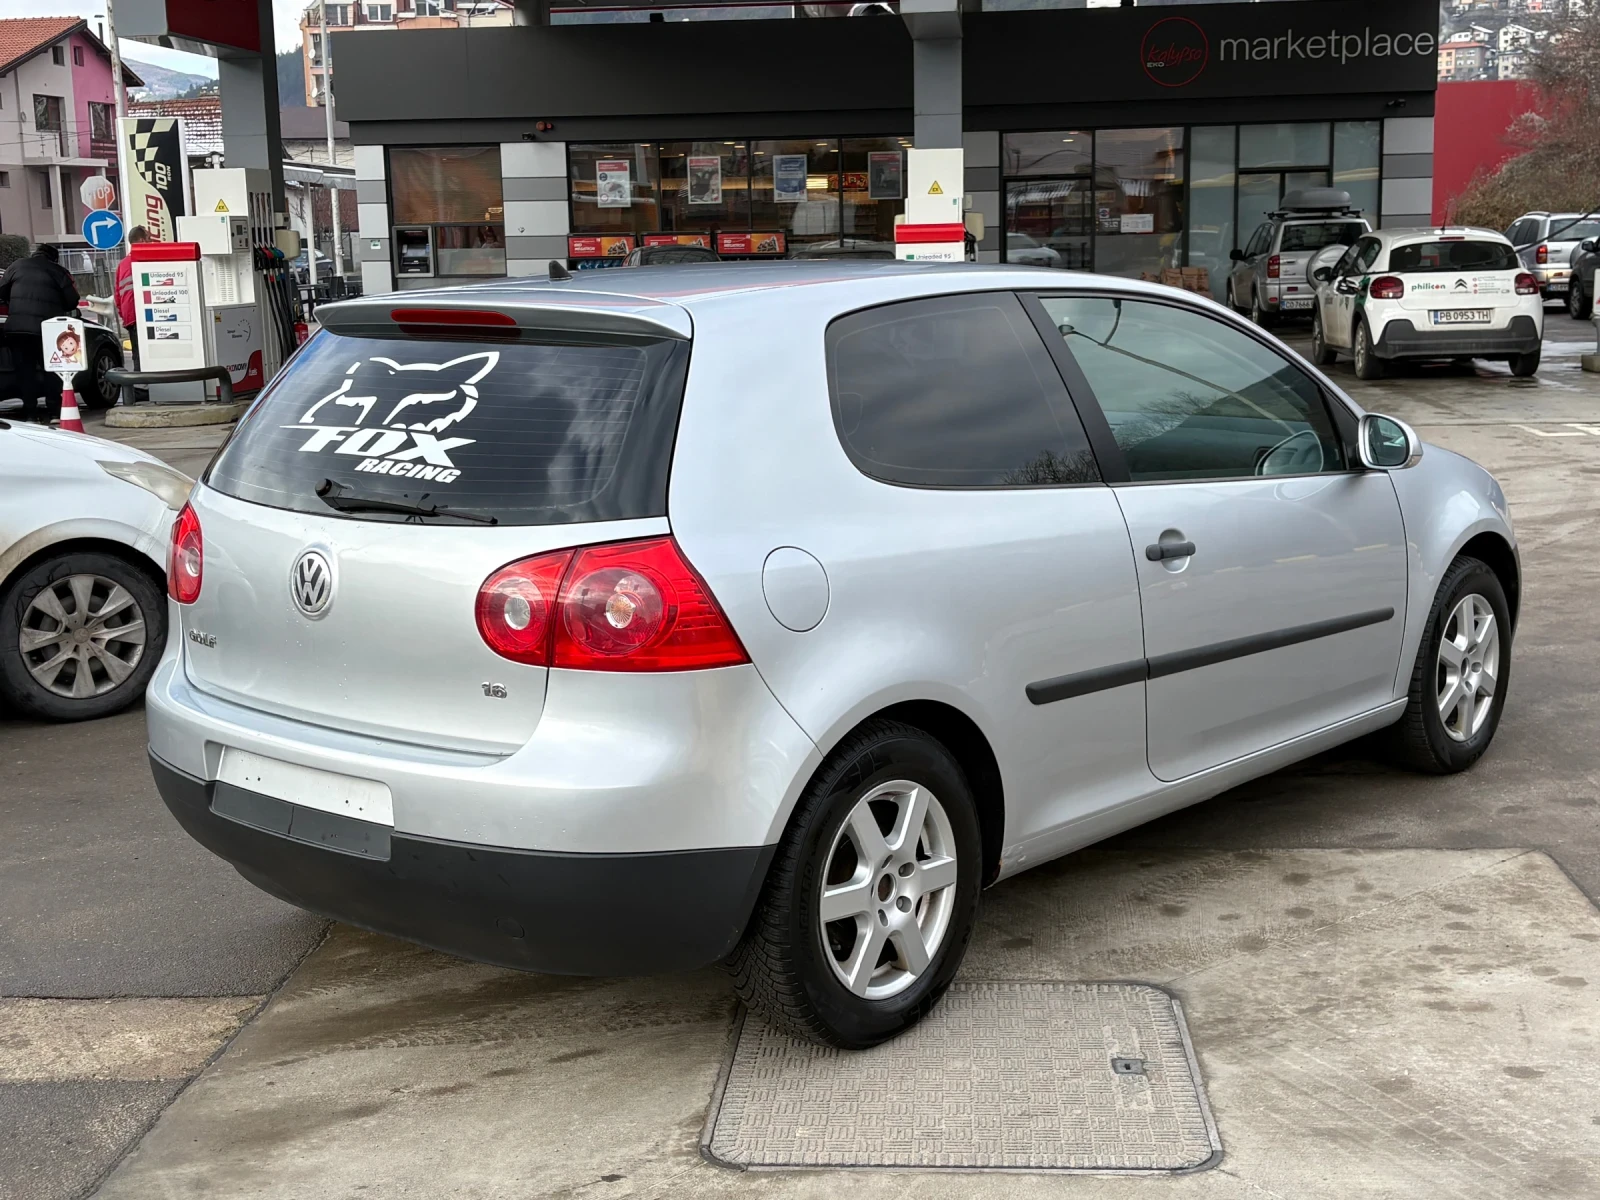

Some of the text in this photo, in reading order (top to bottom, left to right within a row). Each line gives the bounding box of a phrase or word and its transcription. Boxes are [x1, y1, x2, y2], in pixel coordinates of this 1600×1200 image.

[1219, 27, 1435, 64] marketplace
[154, 162, 168, 190] 100
[145, 193, 165, 243] cing
[1411, 283, 1446, 292] philicon
[1440, 311, 1489, 321] PB 0953 TH
[280, 424, 477, 468] FOX
[354, 457, 462, 485] RACING
[189, 628, 217, 648] GOLF
